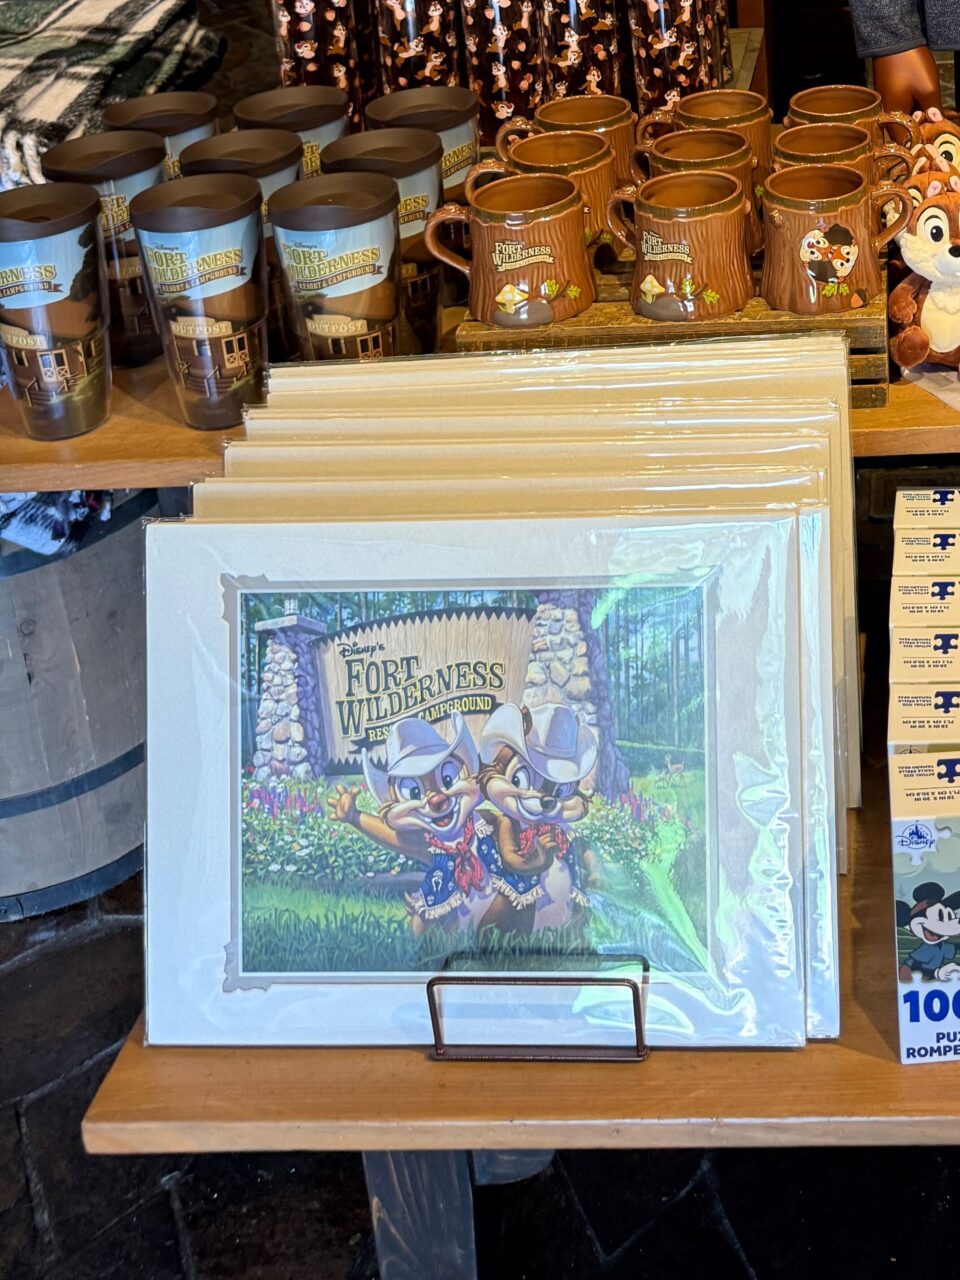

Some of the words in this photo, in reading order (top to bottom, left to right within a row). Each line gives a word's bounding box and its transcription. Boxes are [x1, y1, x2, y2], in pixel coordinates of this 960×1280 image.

[494, 242, 523, 255] FORT
[641, 240, 690, 255] WILDERNESS
[642, 231, 663, 246] FORT
[144, 245, 188, 268] FORT
[282, 243, 327, 265] FORT
[286, 246, 380, 281] WILDERNESS
[491, 246, 551, 266] WILDERNESS
[328, 263, 375, 285] CAMPGROUND
[172, 322, 229, 335] OUTPOST
[307, 320, 363, 333] OUTPOST
[337, 641, 386, 658] Disney's
[345, 655, 420, 697] FORT
[336, 661, 506, 737] WILDERNESS
[368, 726, 393, 741] RES
[418, 696, 492, 722] CAMPGROUND
[895, 835, 936, 850] Disney
